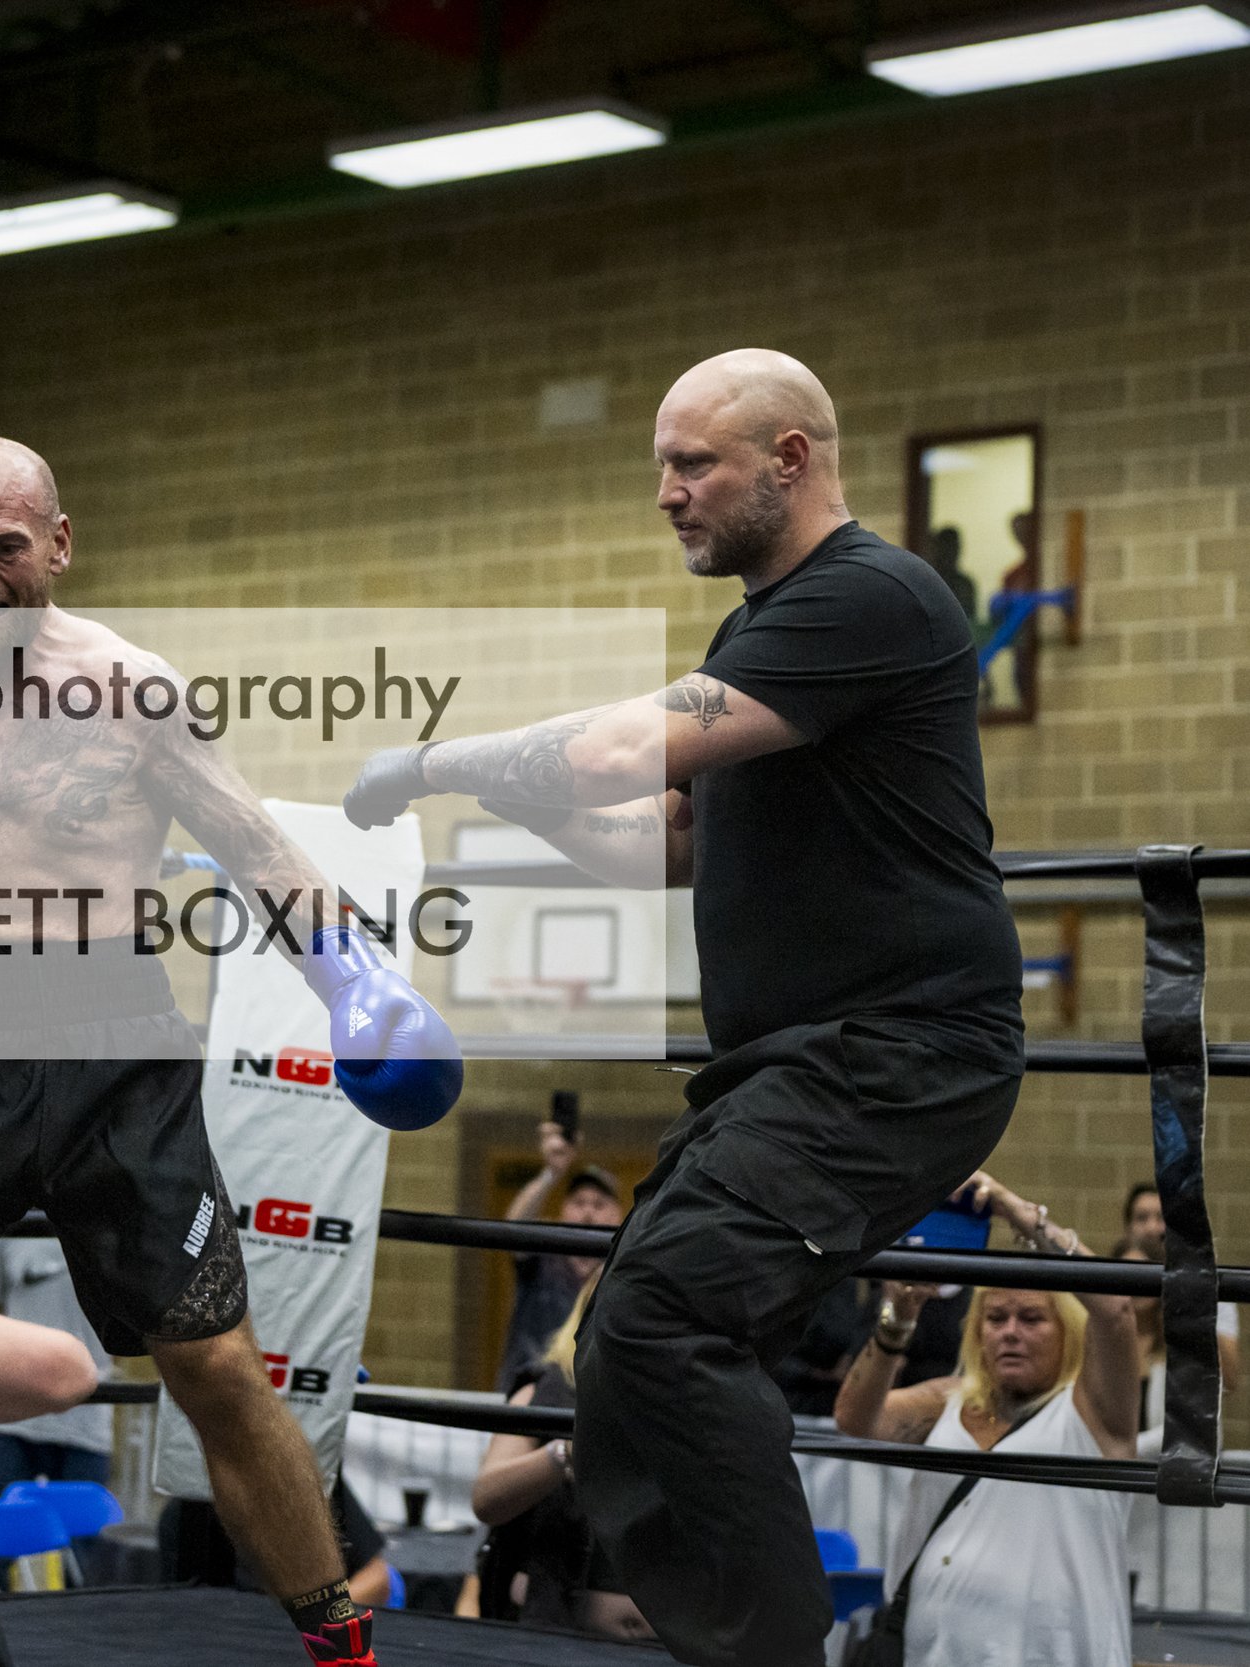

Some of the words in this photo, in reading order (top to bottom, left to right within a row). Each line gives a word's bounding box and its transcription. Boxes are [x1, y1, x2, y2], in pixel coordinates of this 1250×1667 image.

[230, 1077, 291, 1094] BOXING
[232, 1047, 341, 1089] NG
[182, 1191, 216, 1259] AUBREE
